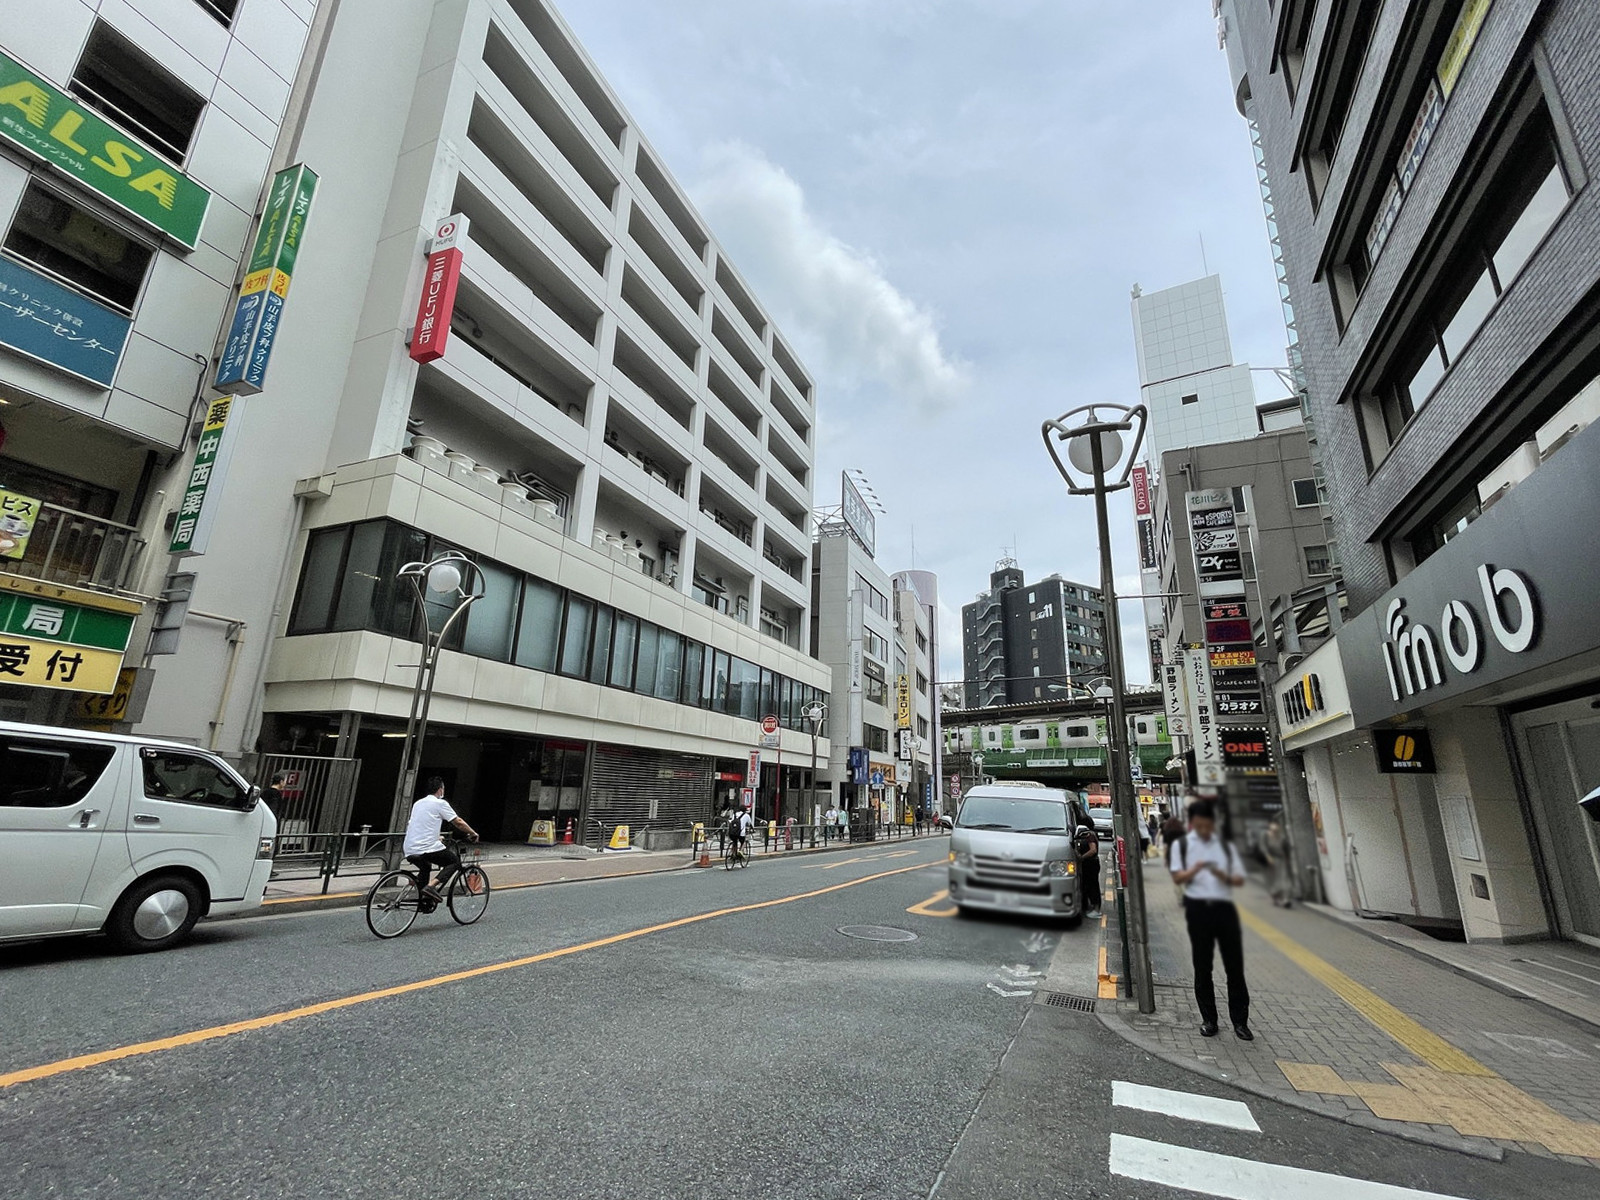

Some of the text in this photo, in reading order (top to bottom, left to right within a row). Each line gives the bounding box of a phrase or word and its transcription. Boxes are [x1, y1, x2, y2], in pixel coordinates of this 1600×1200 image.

[0, 80, 178, 211] ALSA
[274, 176, 292, 210] レイク
[259, 209, 282, 258] ALSA
[419, 257, 446, 345] 三菱UFJ銀行
[207, 400, 230, 426] 薬
[2, 496, 32, 516] ビス
[173, 435, 219, 544] 中西薬局
[10, 579, 66, 597] します
[22, 604, 65, 636] 局
[1382, 564, 1534, 701] imob
[0, 645, 83, 682] 受付
[84, 693, 127, 715] くすり
[1166, 666, 1180, 714] 野郎ラーメン
[1220, 701, 1259, 711] カラオケ
[1198, 705, 1214, 760] 野郎ラーメン
[1225, 743, 1265, 753] ONE
